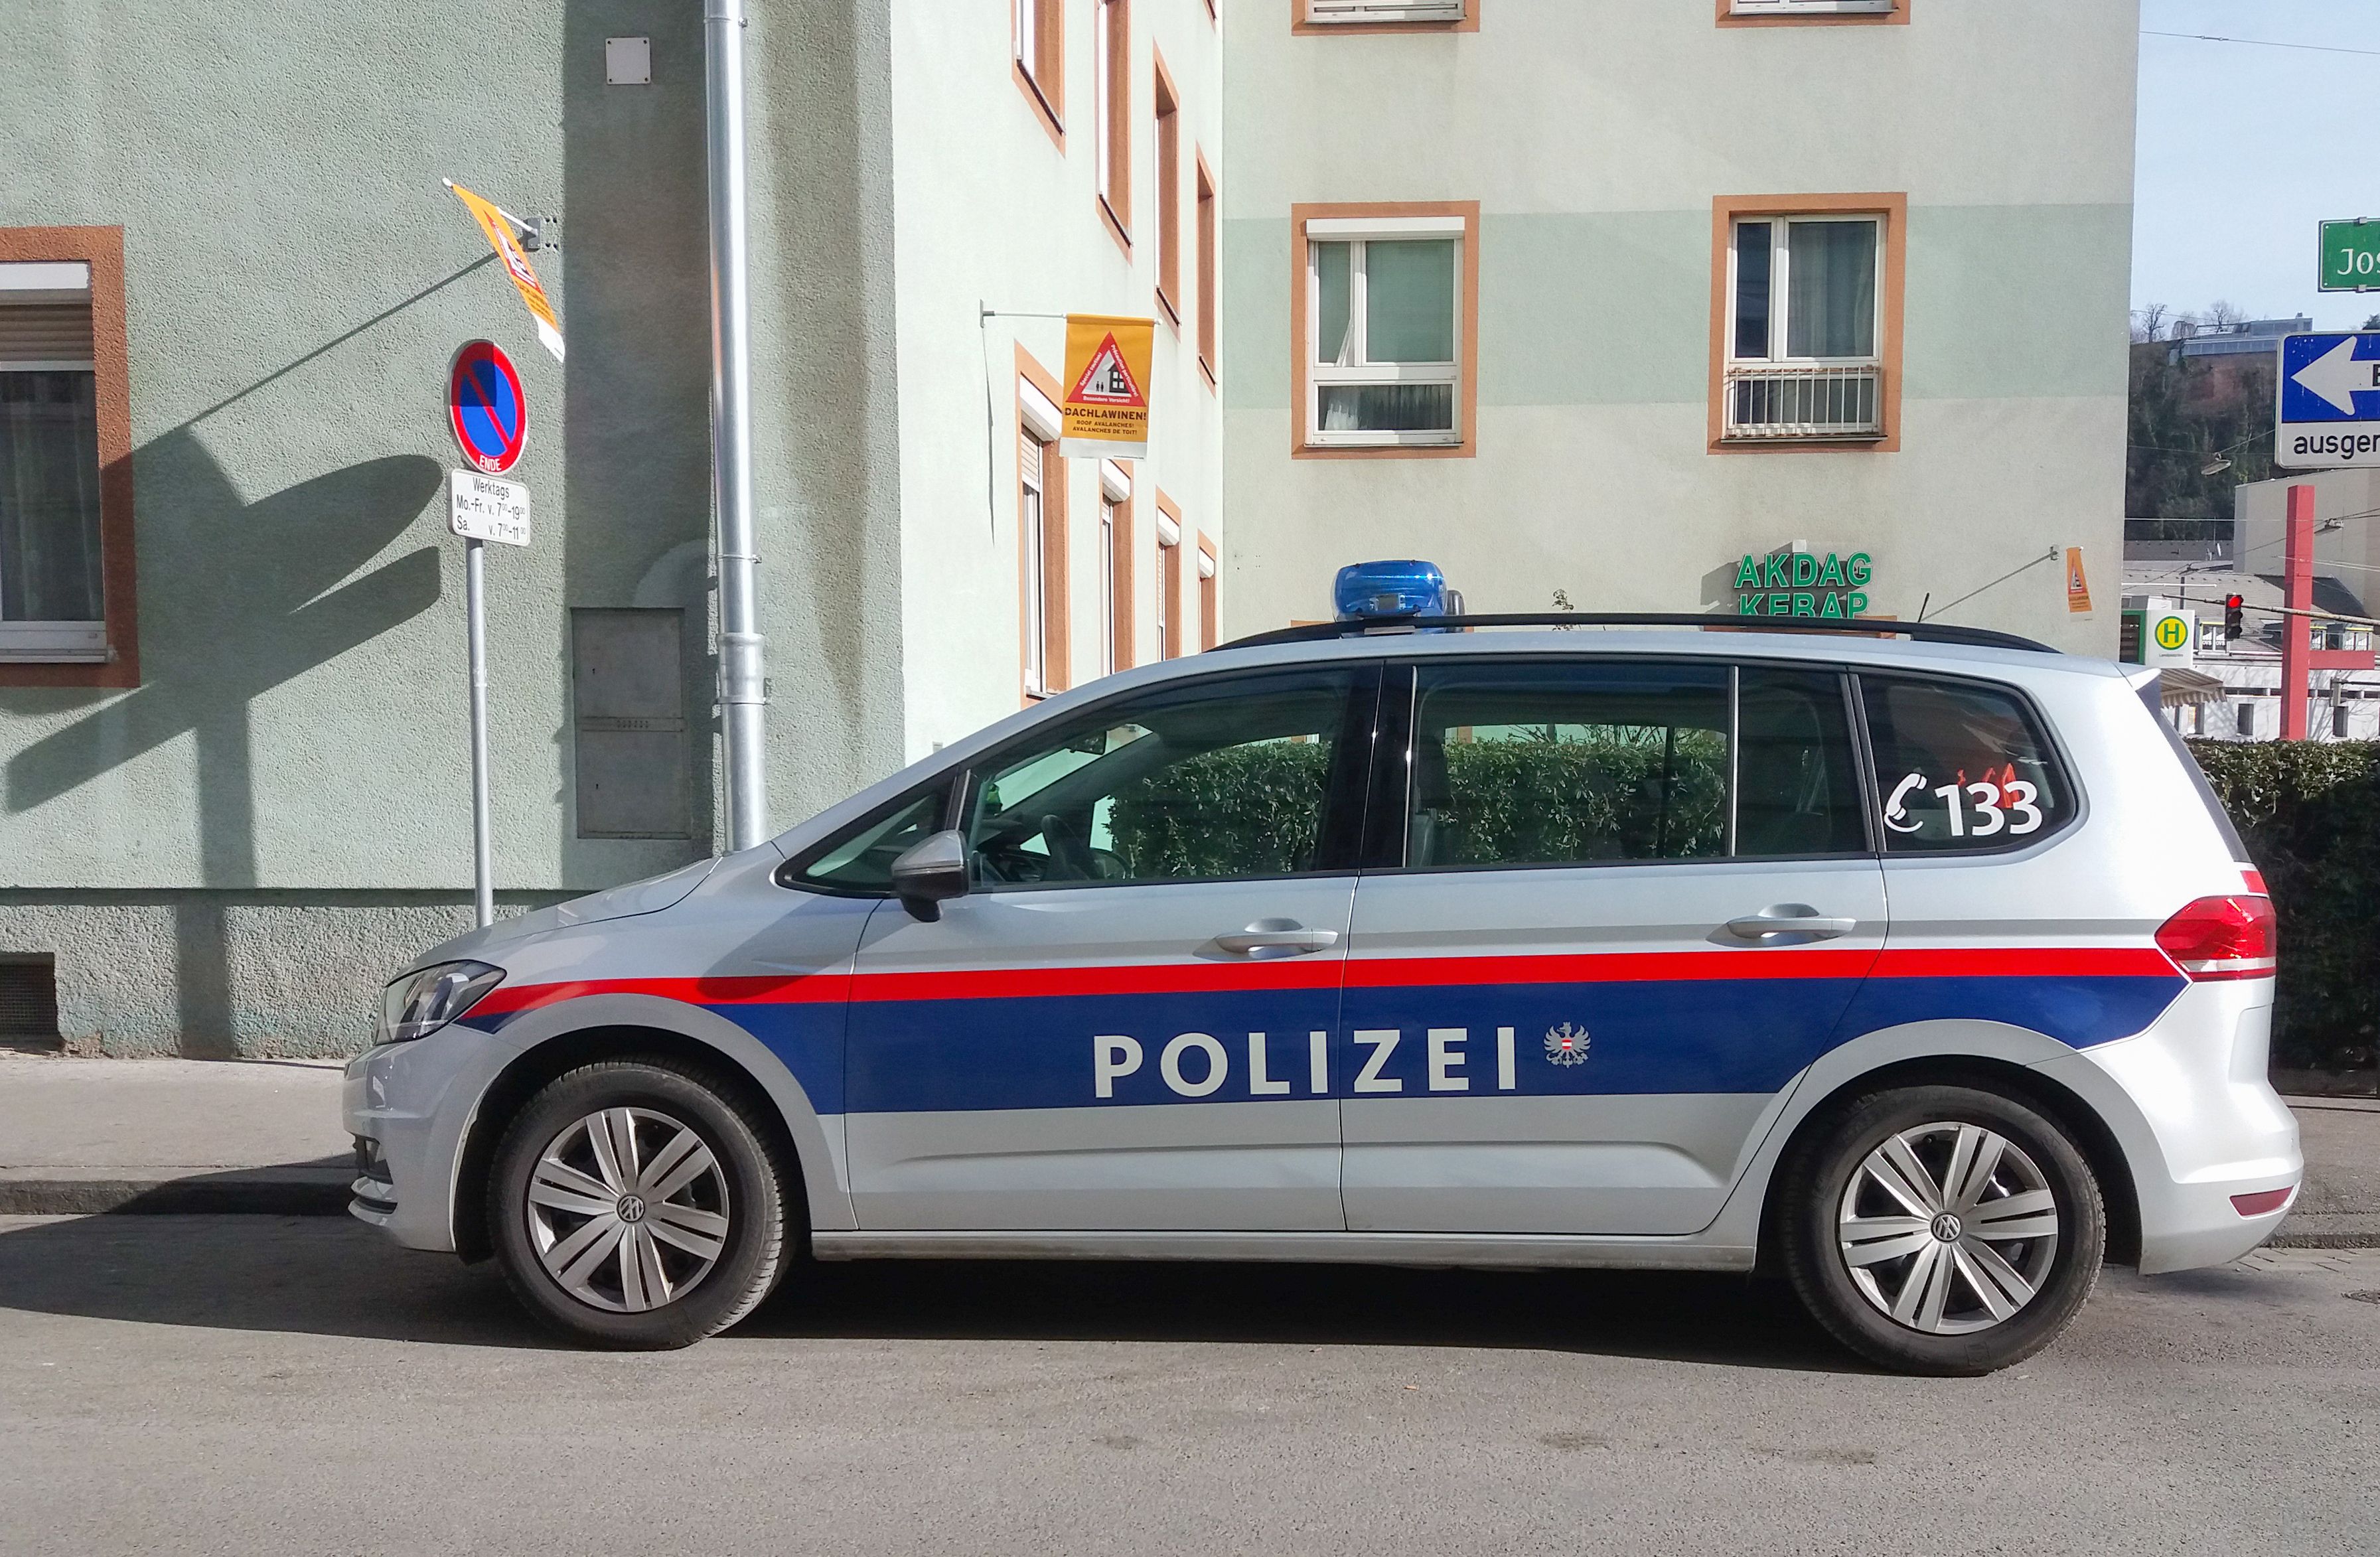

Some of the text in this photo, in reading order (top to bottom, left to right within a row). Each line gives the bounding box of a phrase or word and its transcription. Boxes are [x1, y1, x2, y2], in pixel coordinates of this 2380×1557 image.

[1065, 408, 1147, 420] DACHLAWINEN!
[479, 455, 502, 471] ENDE
[473, 477, 510, 500] Werktags
[488, 504, 494, 516] v.
[457, 515, 470, 532] Sa.
[488, 525, 495, 536] v.
[1734, 552, 1873, 589] AKDAG
[1934, 780, 2043, 836] 133
[1092, 1026, 1517, 1098] POLIZEI
